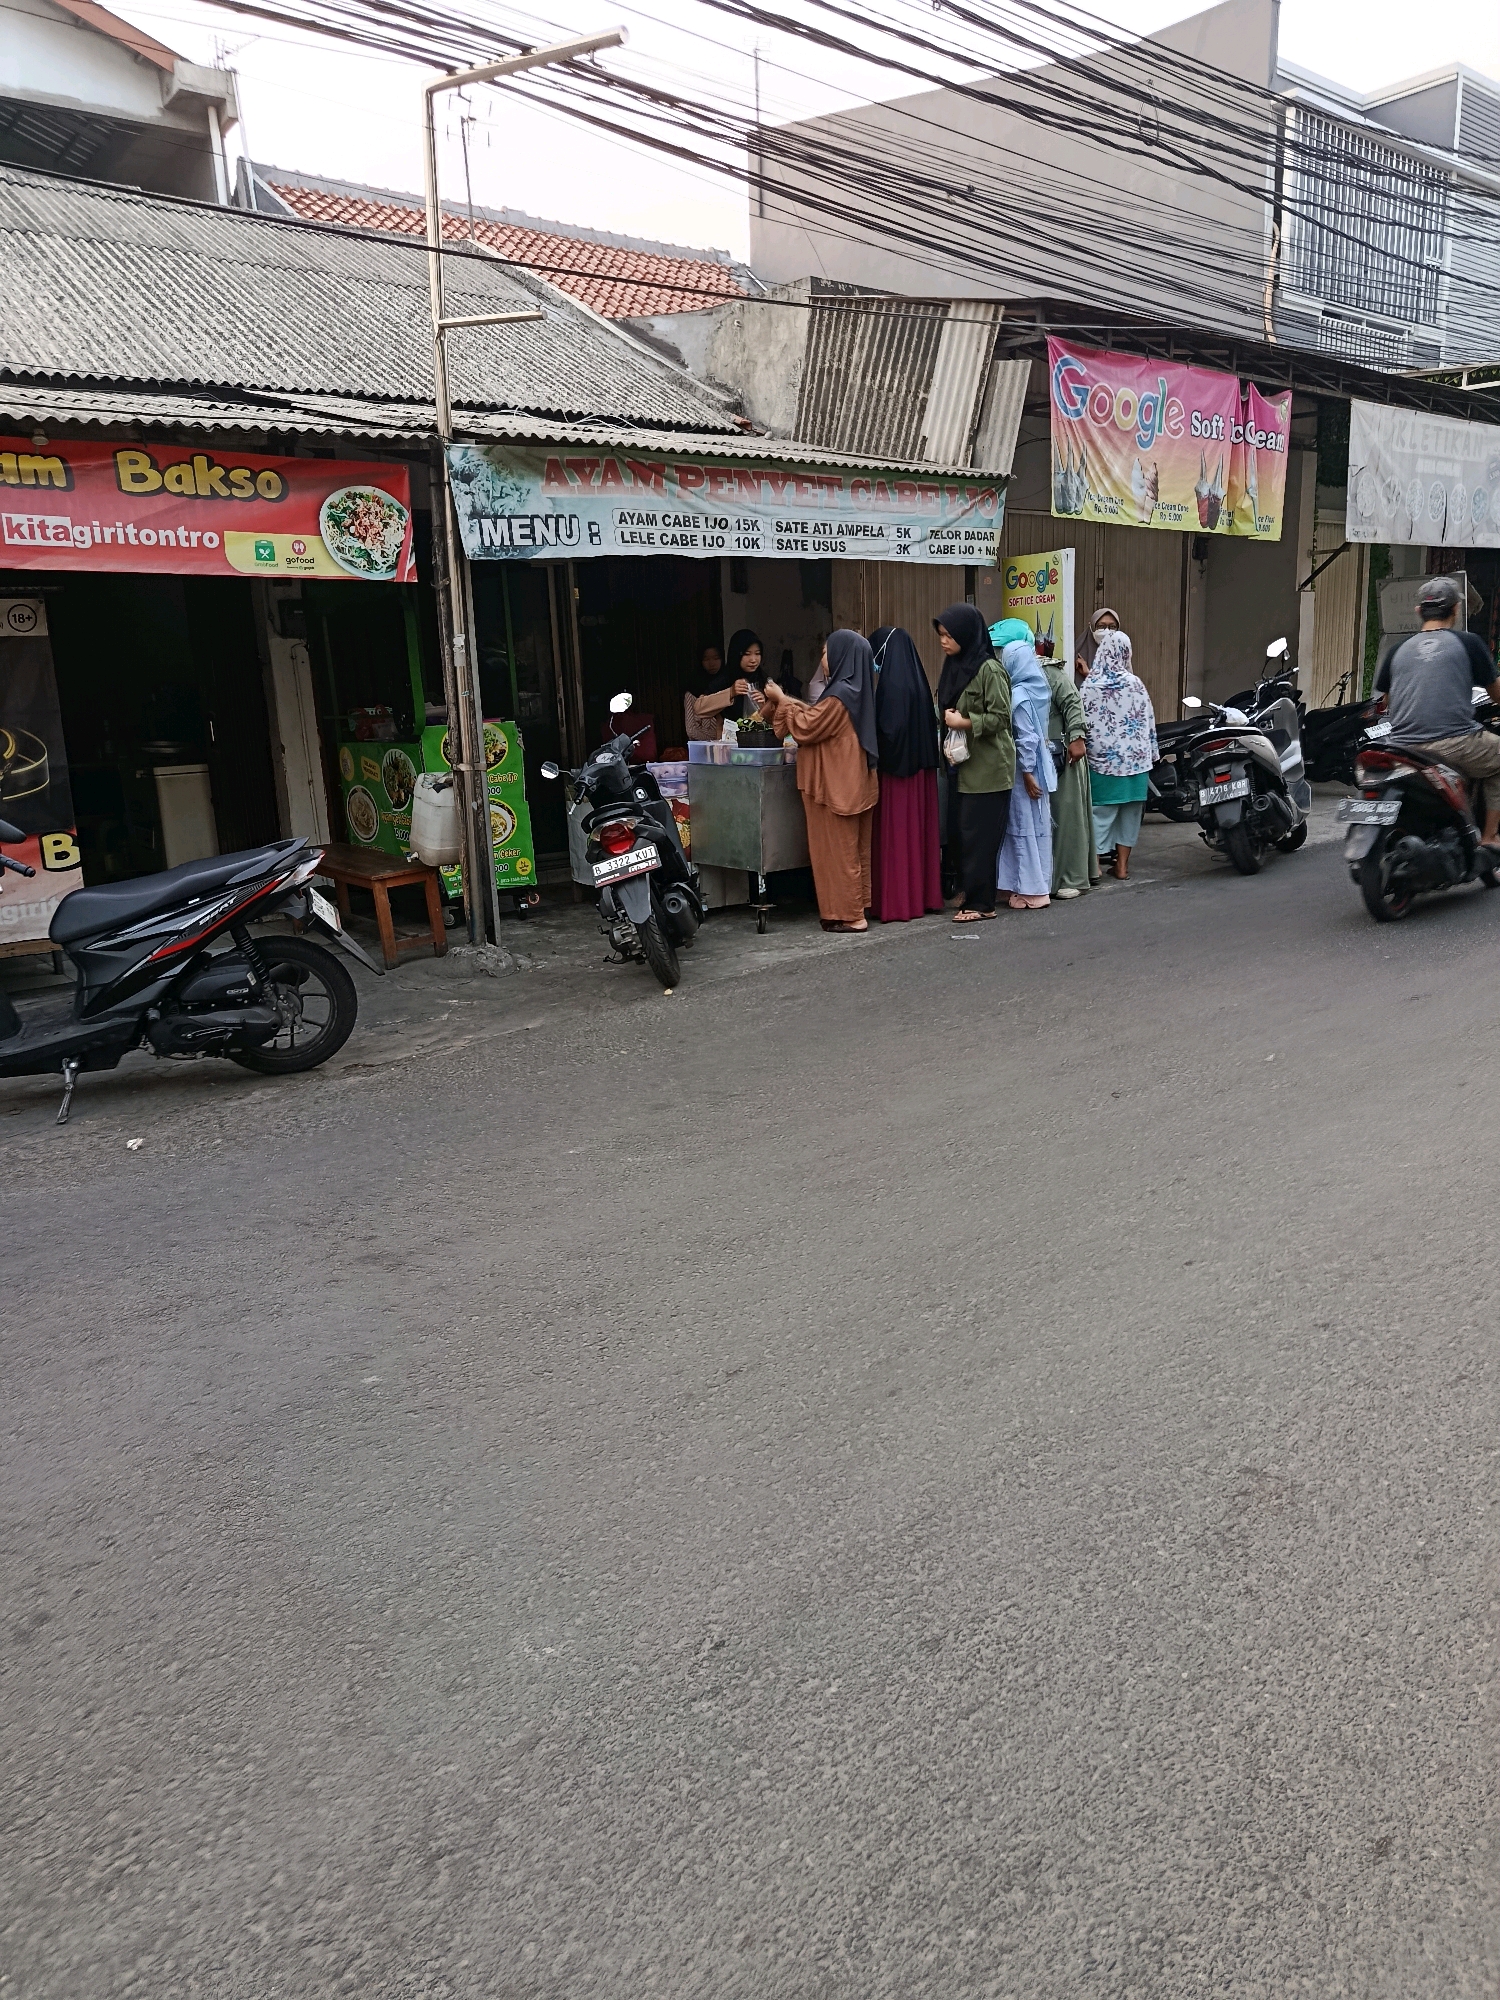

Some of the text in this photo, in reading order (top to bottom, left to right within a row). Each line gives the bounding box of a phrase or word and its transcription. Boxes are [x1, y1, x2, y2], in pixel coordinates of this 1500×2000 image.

[1052, 354, 1185, 451] Google
[1191, 410, 1225, 441] Soft
[116, 450, 283, 499] Bakso
[541, 457, 999, 519] AYAM PENYET CABE IJO
[618, 512, 761, 532] AYAM CABE IJO 15K
[1168, 512, 1183, 522] 5.000
[3, 513, 220, 549] kitagiritontro
[480, 514, 581, 546] MENU
[775, 520, 912, 540] SATE ATI AMPELA 5K
[929, 529, 995, 542] TELOR DADAR
[620, 531, 761, 550] LELE CABE IJO 10K
[776, 538, 911, 556] SATE USUS 3K
[928, 543, 955, 556] CABE
[958, 544, 975, 556] IJO
[285, 556, 315, 565] gofood
[1005, 561, 1059, 593] Google
[1008, 593, 1056, 607] SOFT ICE CREAM
[11, 613, 33, 624] 18+
[499, 849, 520, 859] Ceker
[606, 855, 631, 871] 3322
[635, 847, 653, 861] KUT
